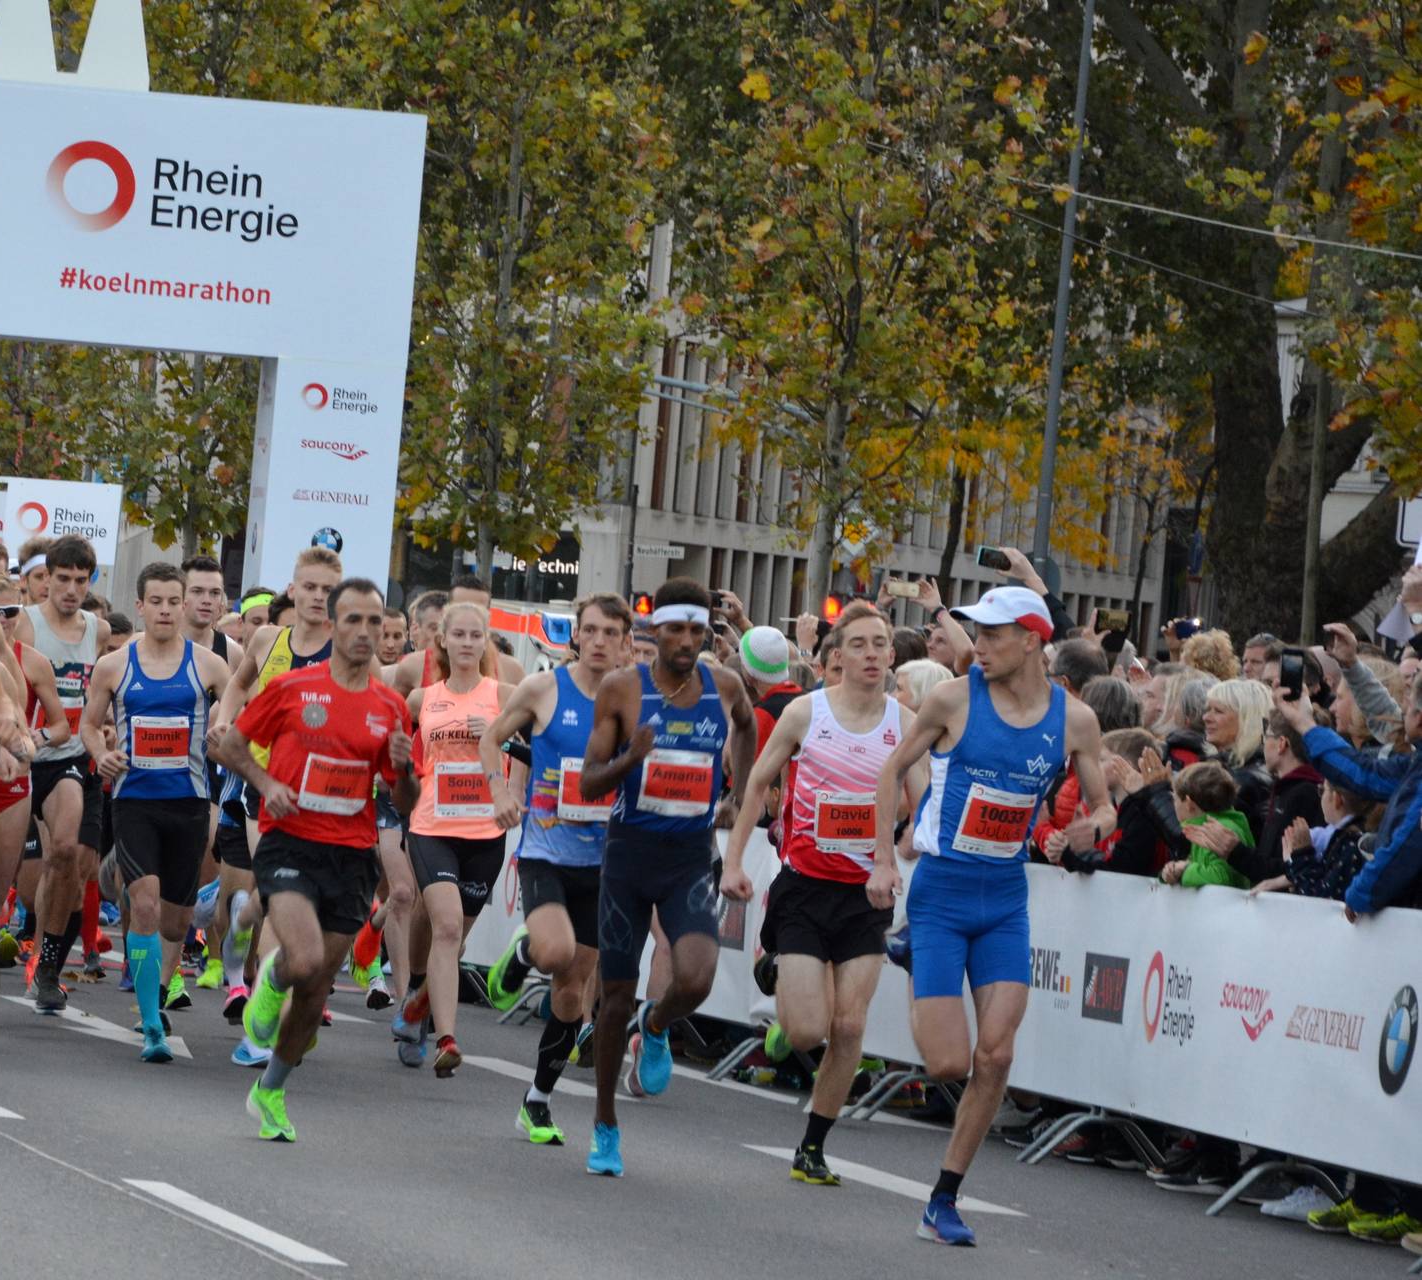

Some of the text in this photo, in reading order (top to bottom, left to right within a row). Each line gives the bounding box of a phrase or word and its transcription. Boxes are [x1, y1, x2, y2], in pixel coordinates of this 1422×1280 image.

[153, 157, 263, 198] Rhein
[150, 194, 299, 243] Energie
[59, 266, 272, 305] #koelnmarathon
[333, 387, 368, 402] Rhein
[332, 399, 379, 415] Energie
[300, 438, 356, 454] saucony
[311, 490, 370, 506] GENERALI
[54, 507, 95, 523] Rhein
[53, 521, 108, 540] Energie
[538, 557, 579, 575] echni
[140, 731, 182, 741] Jannik
[447, 776, 483, 789] Sonja
[829, 807, 871, 820] David
[979, 804, 1026, 825] 10033
[1165, 964, 1193, 1001] Rhein
[1219, 981, 1268, 1021] saucony
[1161, 1001, 1196, 1047] Energie
[1302, 1006, 1366, 1052] GENERALI
